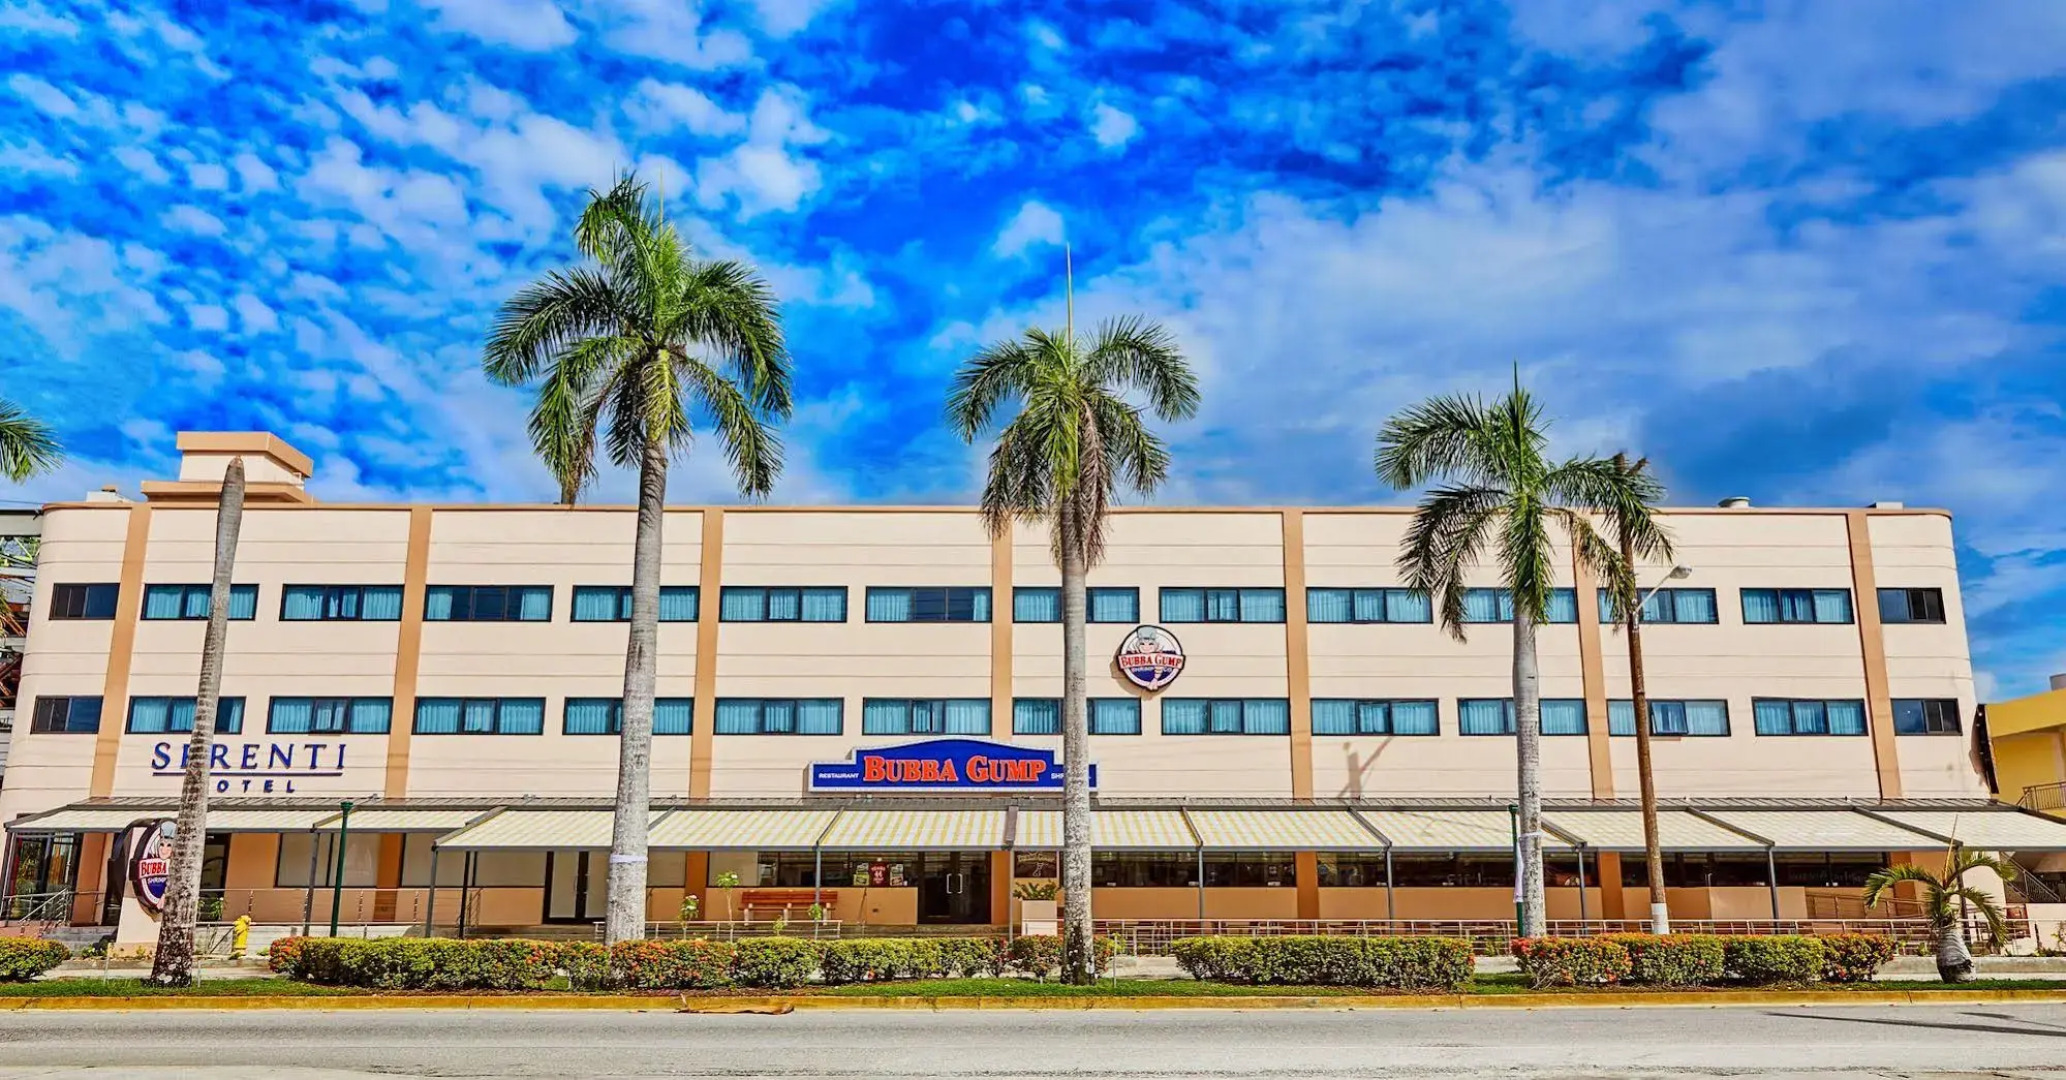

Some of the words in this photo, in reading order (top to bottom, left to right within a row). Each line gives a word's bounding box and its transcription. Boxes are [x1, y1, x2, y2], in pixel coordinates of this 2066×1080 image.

[1120, 656, 1153, 667] BUBBA
[1154, 653, 1183, 667] GUMP
[862, 755, 959, 782] BUBBA
[966, 755, 1047, 782] GUMP
[216, 779, 296, 793] OTEL
[141, 861, 167, 876] BUBBA
